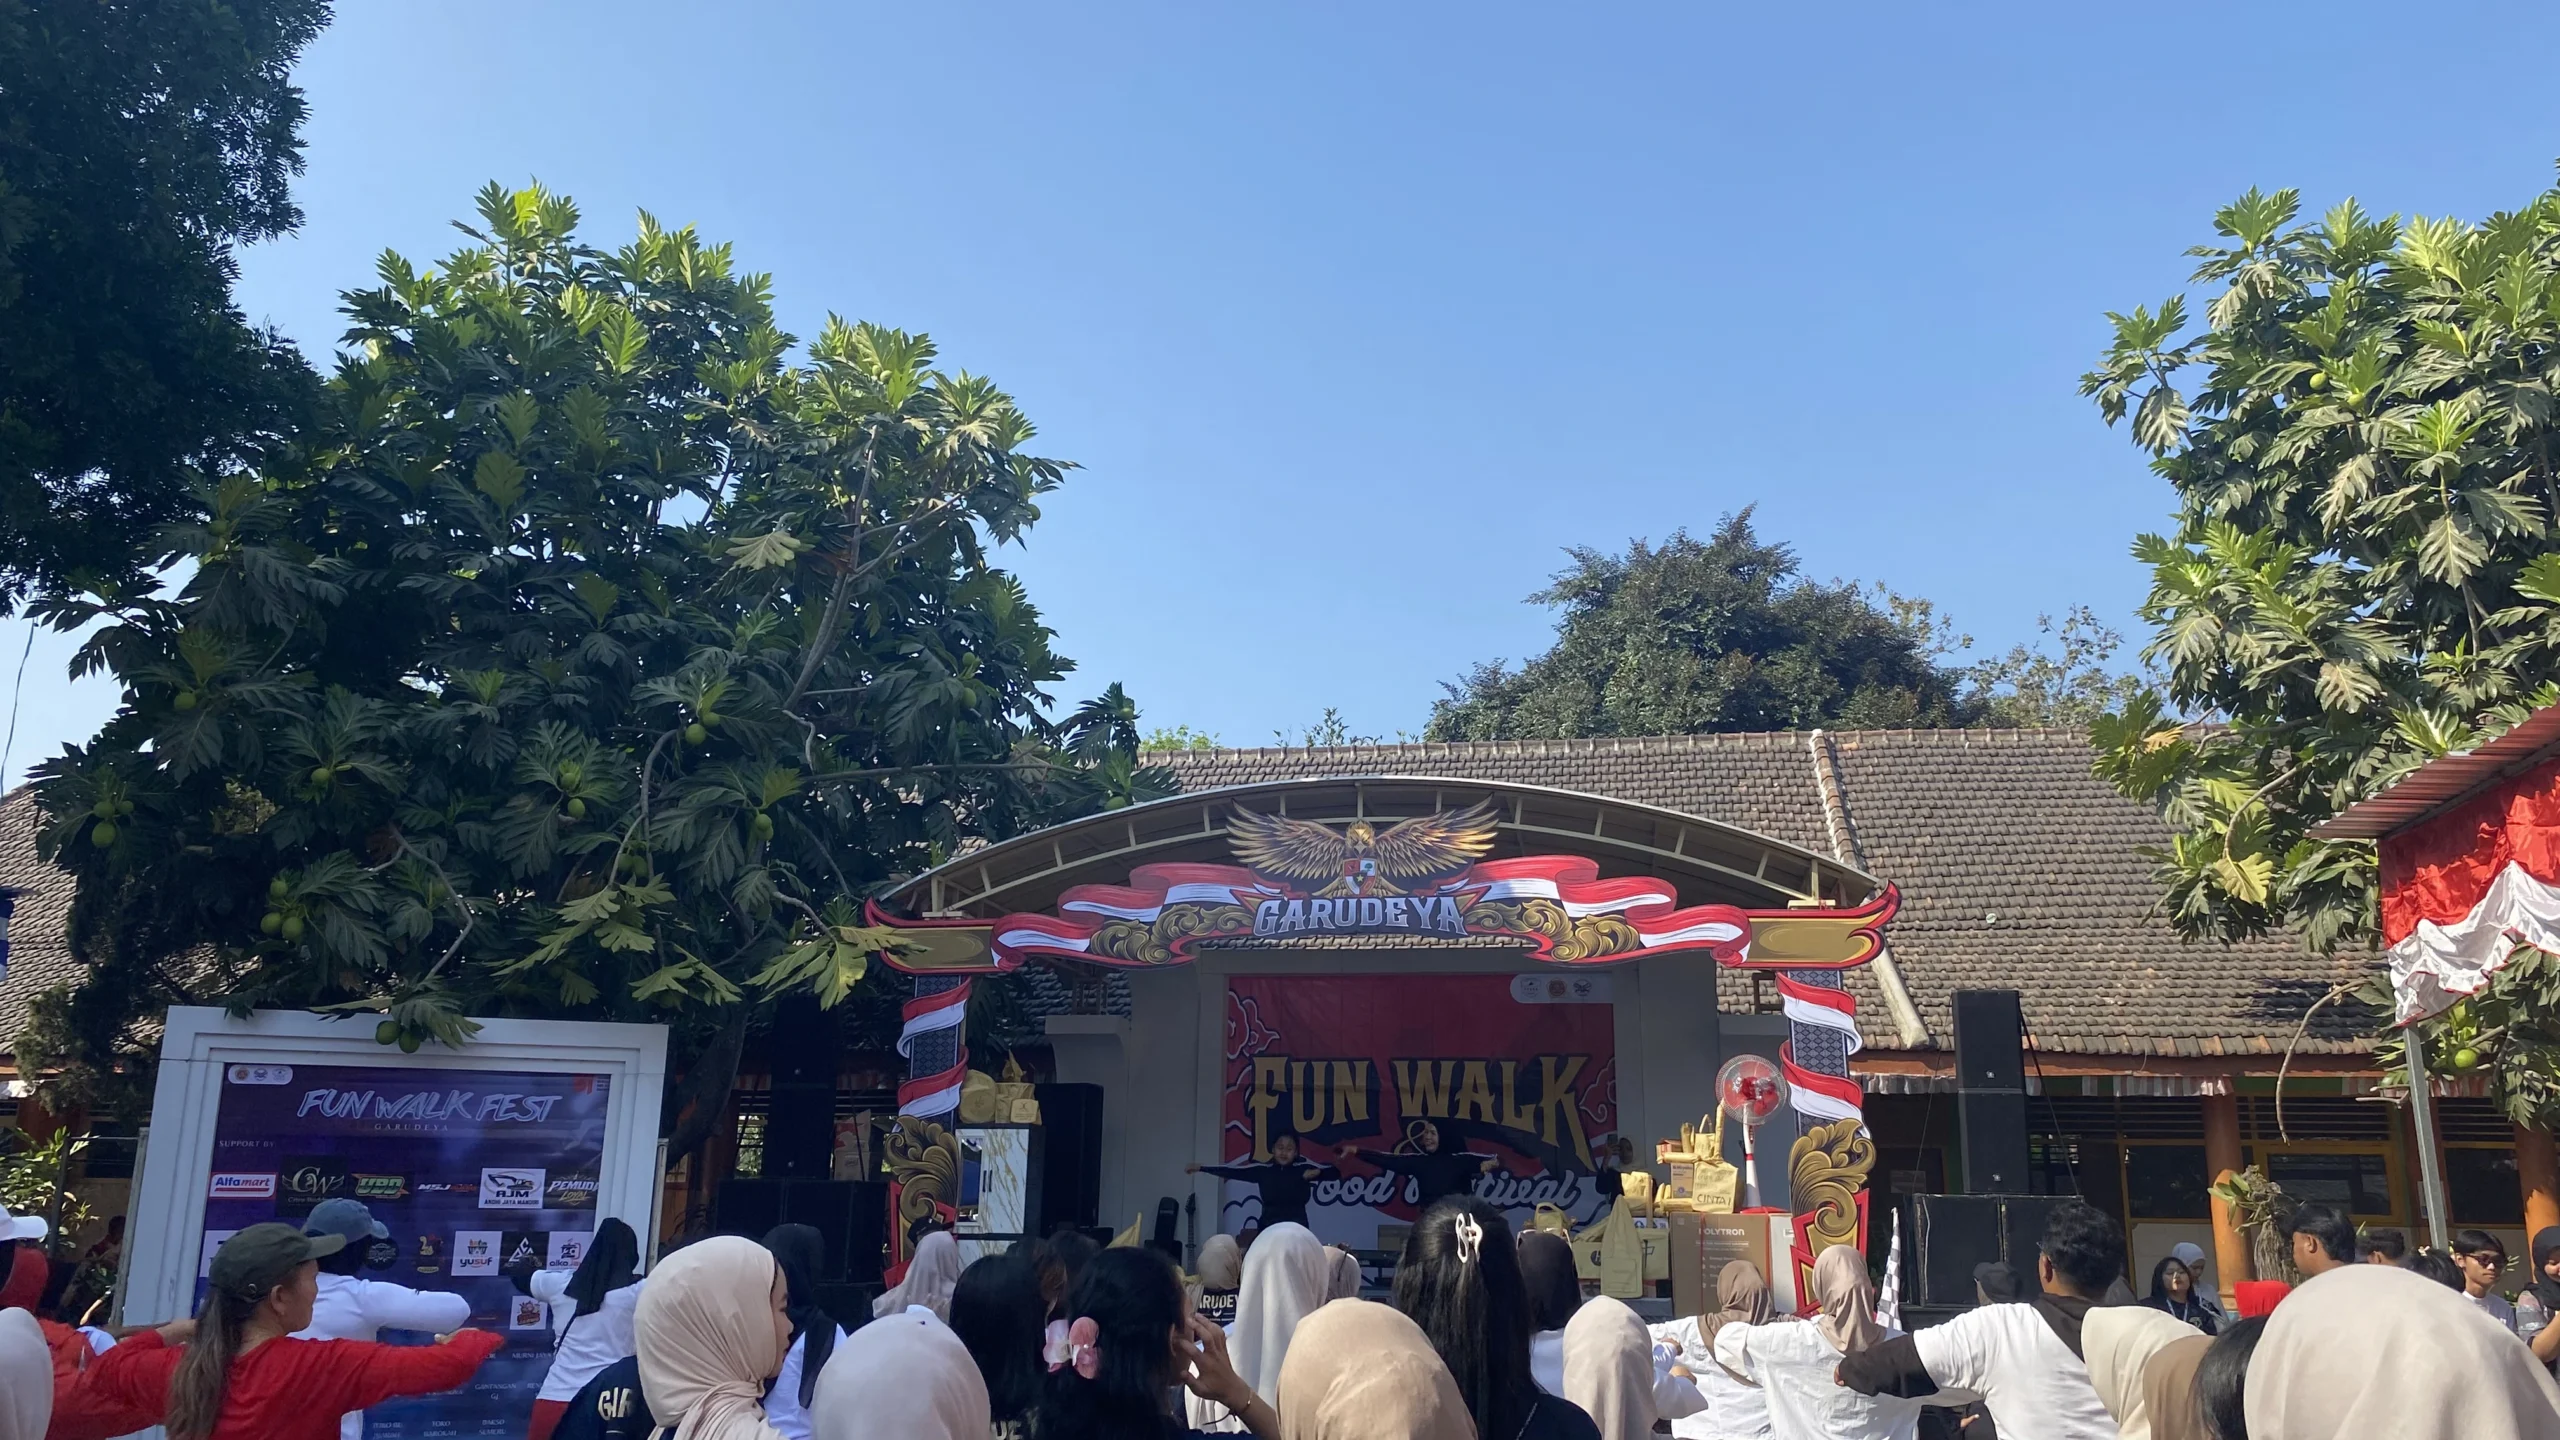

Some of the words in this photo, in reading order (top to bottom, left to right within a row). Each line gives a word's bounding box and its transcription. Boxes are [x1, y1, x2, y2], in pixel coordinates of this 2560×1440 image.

[1253, 895, 1468, 936] GARUDEYA
[297, 1088, 375, 1119] FUN
[375, 1090, 474, 1120] WALK
[475, 1093, 563, 1122] FEST
[1248, 1056, 1371, 1162] FUN
[1391, 1056, 1597, 1172] WALK
[374, 1123, 449, 1131] GARUDEYA
[219, 1140, 261, 1148] SUPPORT
[215, 1176, 271, 1187] Alfamart
[1311, 1170, 1397, 1204] ood
[495, 1190, 529, 1198] AJM
[460, 1257, 493, 1268] yusuf
